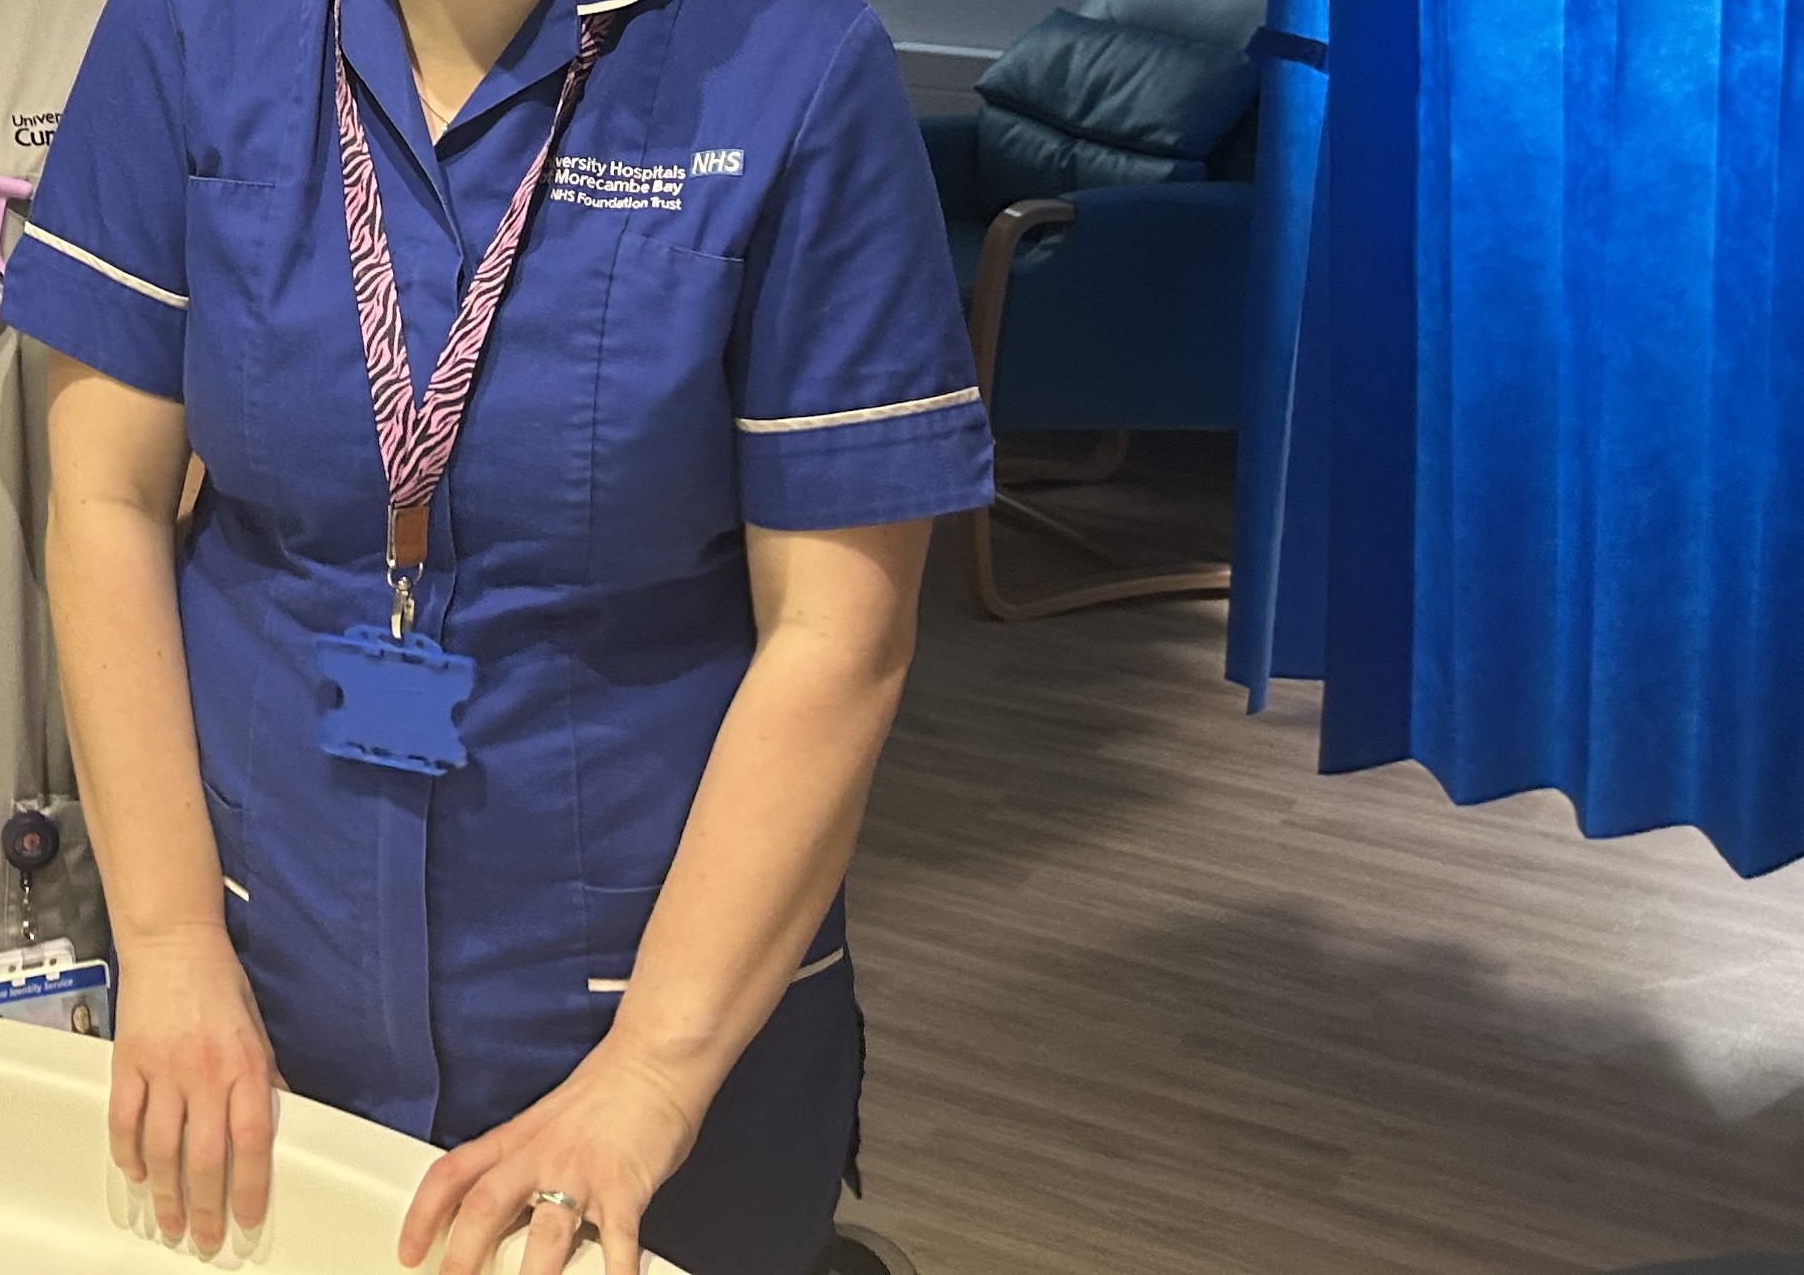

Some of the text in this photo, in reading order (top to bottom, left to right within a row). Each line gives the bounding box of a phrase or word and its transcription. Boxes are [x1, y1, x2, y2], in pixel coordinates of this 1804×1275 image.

[11, 112, 63, 127] Univer
[553, 155, 686, 181] versity Hospitals
[692, 151, 742, 174] NHS
[554, 168, 649, 194] Morecambe
[652, 179, 683, 196] Bay
[550, 188, 682, 211] NHS Foundation Trust
[44, 978, 74, 992] Service
